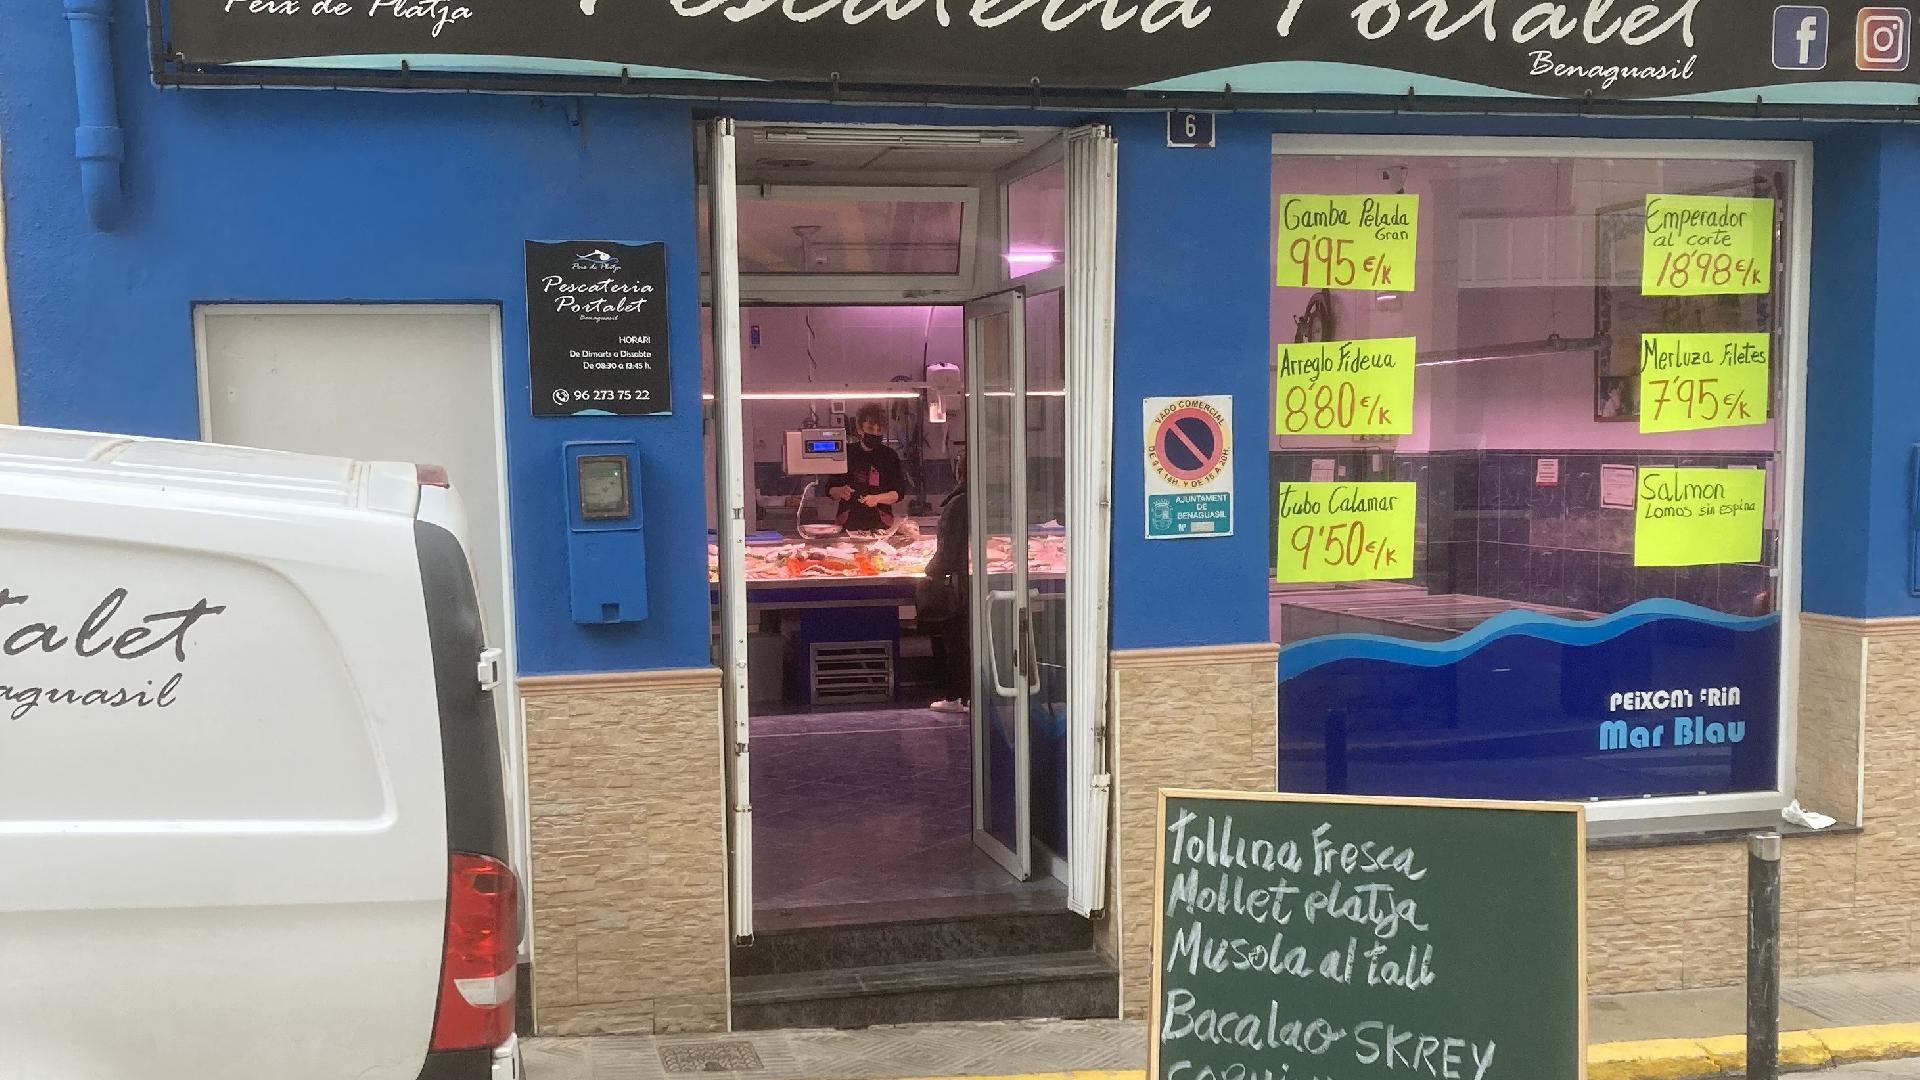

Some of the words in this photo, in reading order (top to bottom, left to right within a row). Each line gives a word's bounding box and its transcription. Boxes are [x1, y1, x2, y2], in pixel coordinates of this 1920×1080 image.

[311, 0, 352, 16] de
[369, 0, 473, 37] Platja
[1529, 51, 1698, 90] Benaguasil
[1185, 114, 1196, 138] 6
[1284, 198, 1350, 230] Gamba
[1359, 198, 1409, 228] Pelada
[1646, 198, 1747, 237] Emperador
[1375, 227, 1408, 240] Gran
[1653, 232, 1674, 246] al
[1687, 229, 1733, 246] corte
[542, 275, 654, 293] Pescateria
[554, 295, 647, 313] Portalet
[619, 336, 651, 344] HORARI
[569, 350, 580, 358] De
[581, 350, 612, 358] Dimarts
[620, 350, 652, 358] Dissabte
[583, 362, 594, 370] De
[1280, 345, 1333, 382] Arreglo
[1337, 342, 1396, 373] Fideua
[1641, 338, 1713, 374] Merluza
[1720, 341, 1766, 366] Filetes
[573, 390, 590, 401] 96
[593, 390, 615, 401] 273
[617, 390, 632, 401] 75
[635, 390, 650, 400] 22
[1155, 404, 1176, 424] VADO
[1178, 399, 1225, 426] COMERCIAL
[1175, 494, 1227, 504] AJUNTAMENT
[1328, 486, 1398, 514] Calamar
[1640, 472, 1725, 501] Salmon
[1177, 511, 1227, 520] BENAGUASIL
[1196, 503, 1208, 511] DE
[1645, 503, 1692, 519] Lomos
[1698, 502, 1716, 517] sin
[1719, 499, 1756, 517] espina
[1600, 720, 1664, 750] Mar
[1674, 716, 1746, 745] Blau
[1312, 822, 1427, 881] Fresca
[1166, 867, 1299, 925] Mollet
[1167, 921, 1314, 978] Musola
[1319, 936, 1358, 985] al
[1364, 940, 1436, 991] tall
[1161, 988, 1347, 1056] Bacalao
[1354, 1020, 1497, 1080] SKREY
